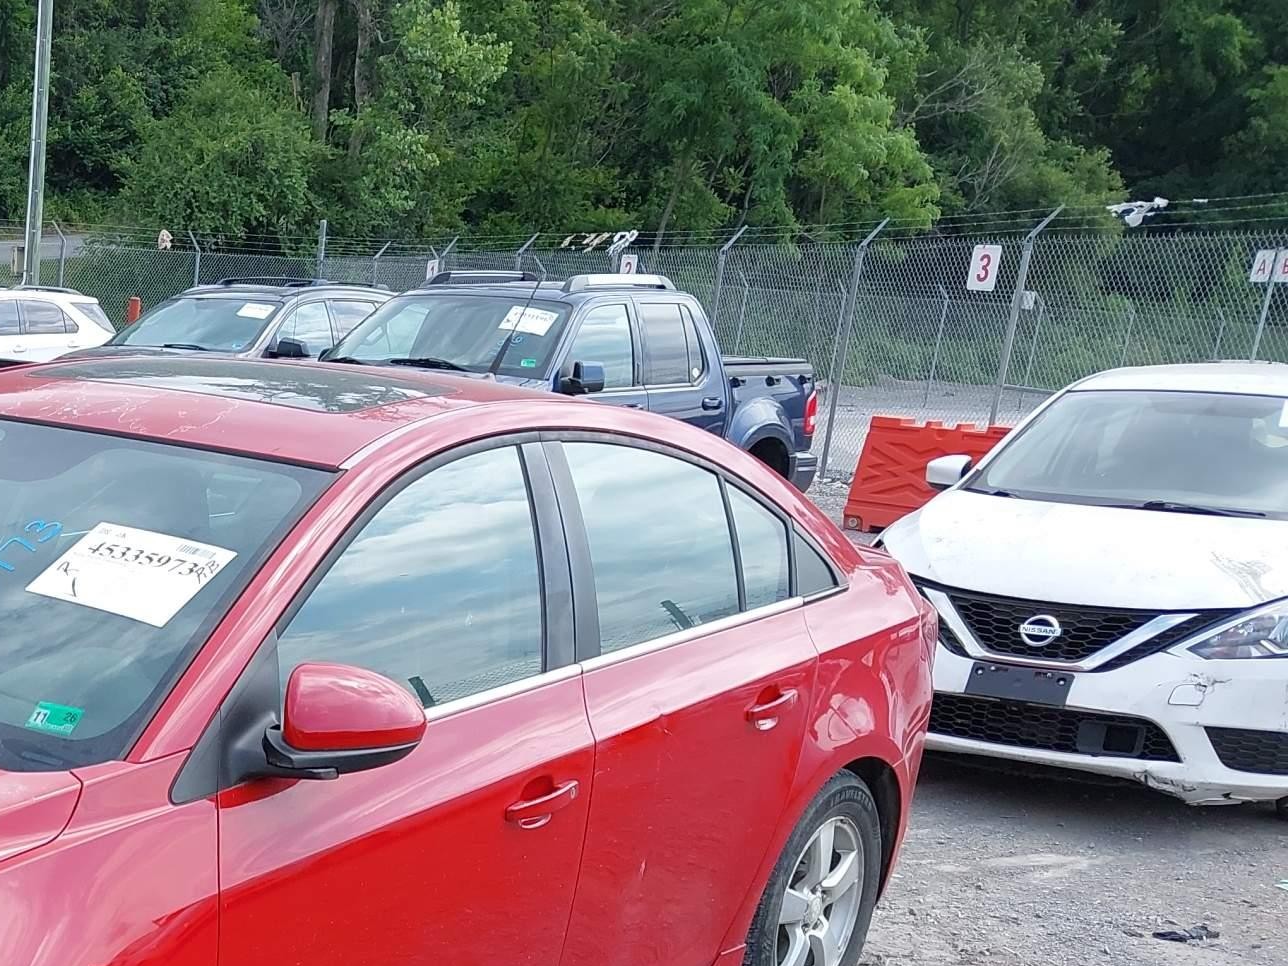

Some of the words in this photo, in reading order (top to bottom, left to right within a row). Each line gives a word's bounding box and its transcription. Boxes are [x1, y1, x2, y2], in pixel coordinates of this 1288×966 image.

[976, 253, 991, 282] 3
[1256, 259, 1266, 275] A
[88, 542, 198, 575] 45335973
[1022, 625, 1058, 635] NISSAN
[33, 711, 48, 724] 11
[63, 711, 78, 723] 26
